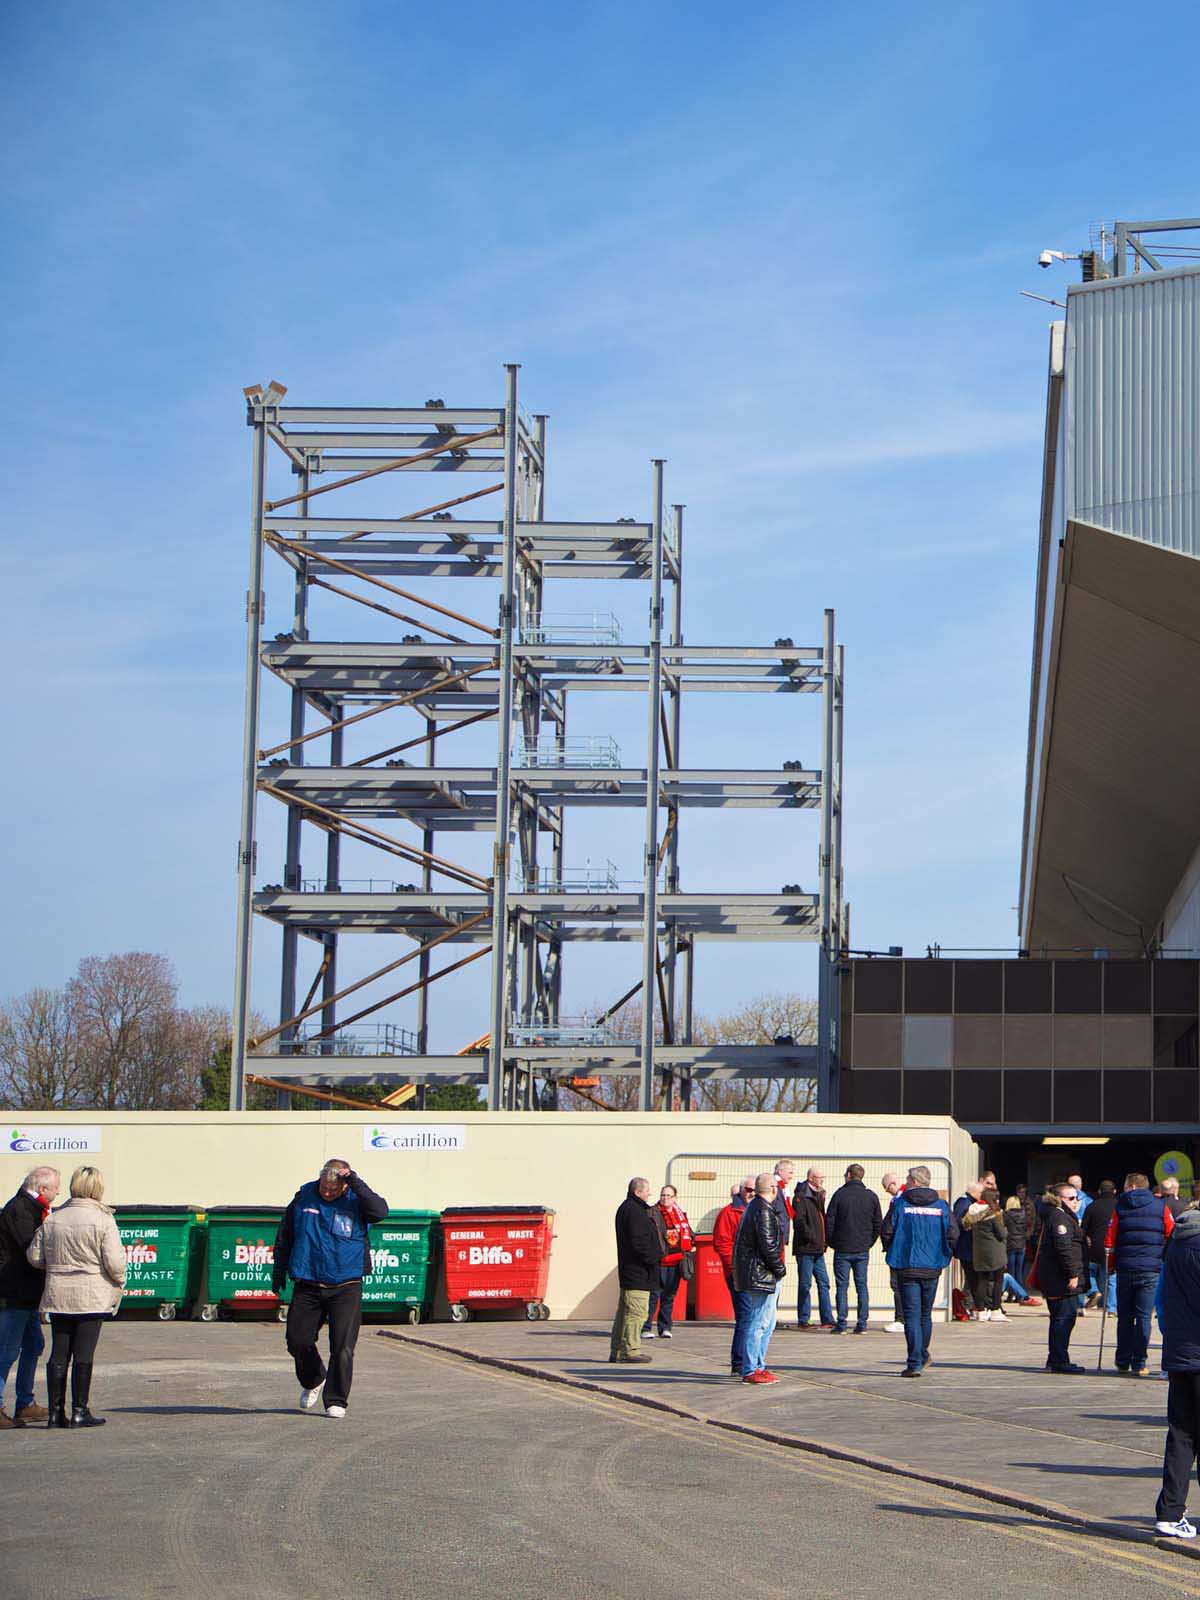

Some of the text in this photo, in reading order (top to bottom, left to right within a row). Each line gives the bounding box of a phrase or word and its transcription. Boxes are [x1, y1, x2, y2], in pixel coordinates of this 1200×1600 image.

[32, 1137, 88, 1151] carillion
[393, 1132, 457, 1148] carillion
[119, 1229, 159, 1238] ECYCLING
[450, 1230, 534, 1240] GENERAL WASTE
[123, 1244, 157, 1263] iffa
[222, 1249, 231, 1260] 9
[369, 1248, 400, 1267] iffa
[469, 1245, 512, 1265] Biffa
[247, 1262, 263, 1272] NO
[223, 1271, 272, 1282] FOODWA
